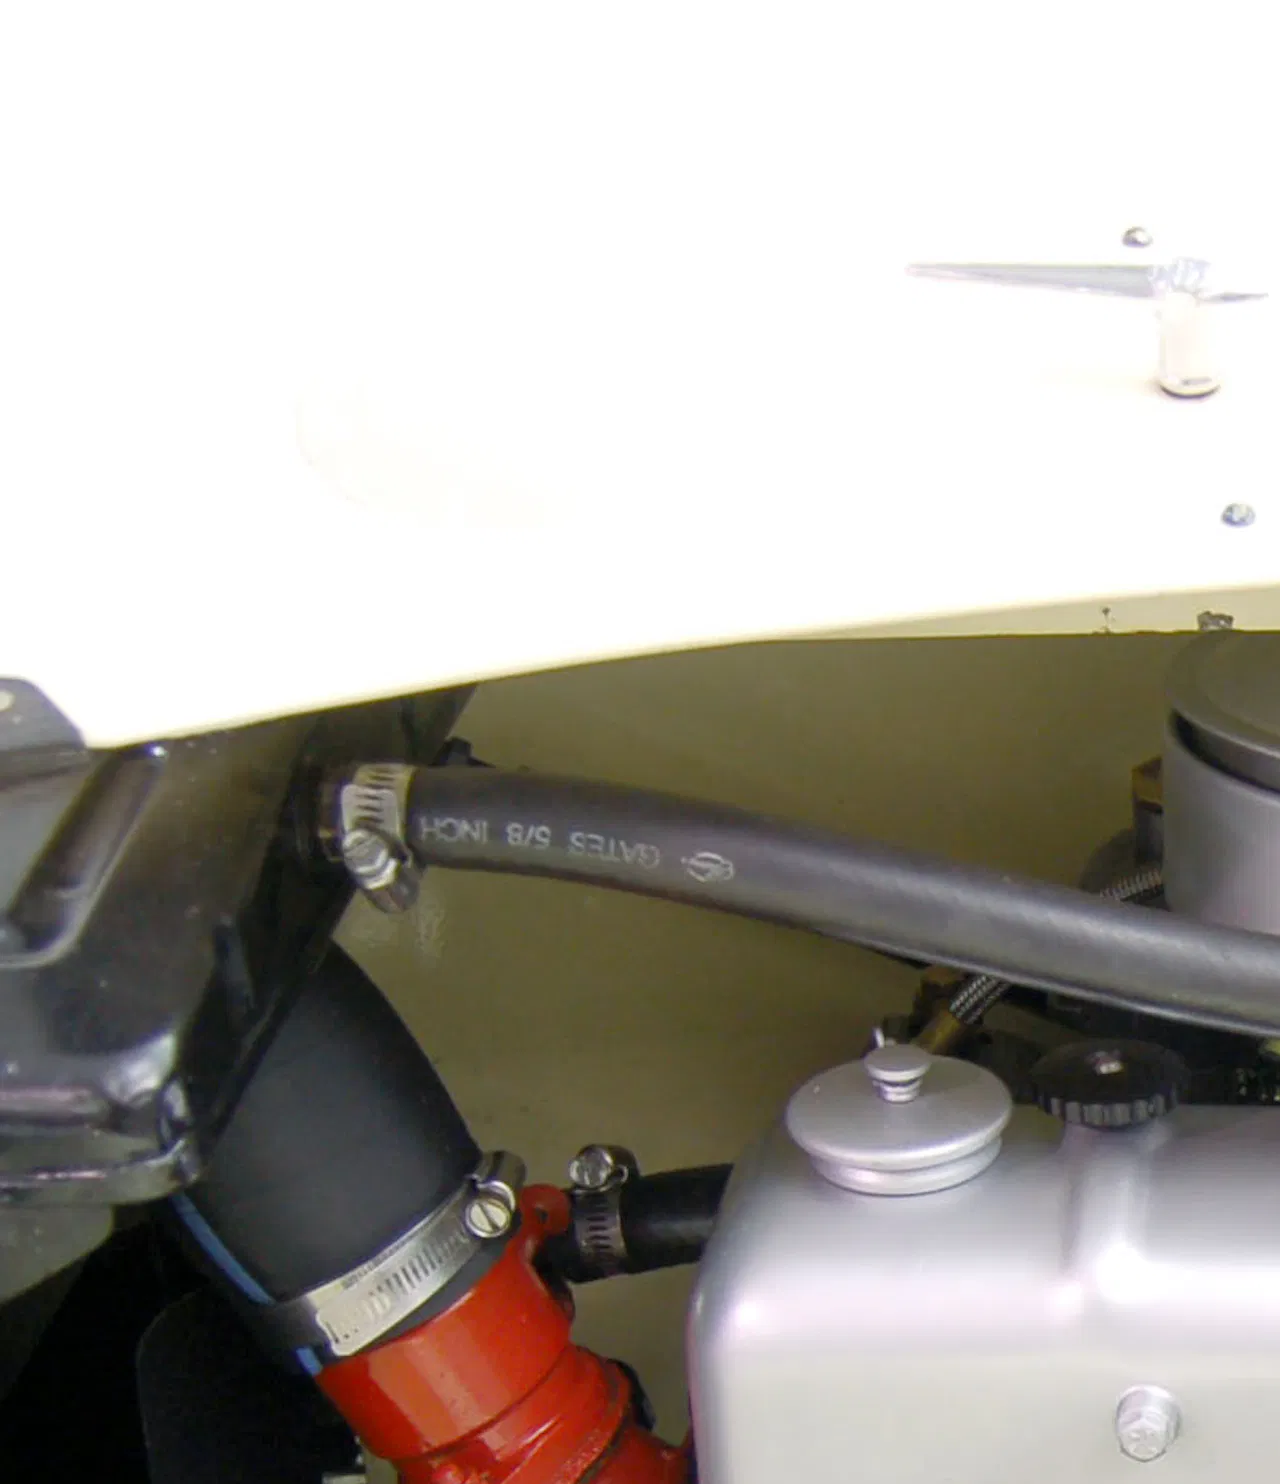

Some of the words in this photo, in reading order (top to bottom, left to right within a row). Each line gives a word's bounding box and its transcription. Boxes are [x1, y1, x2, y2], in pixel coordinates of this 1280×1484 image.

[419, 814, 489, 846] INCH
[505, 820, 553, 850] 5/8
[568, 832, 662, 870] GATES
